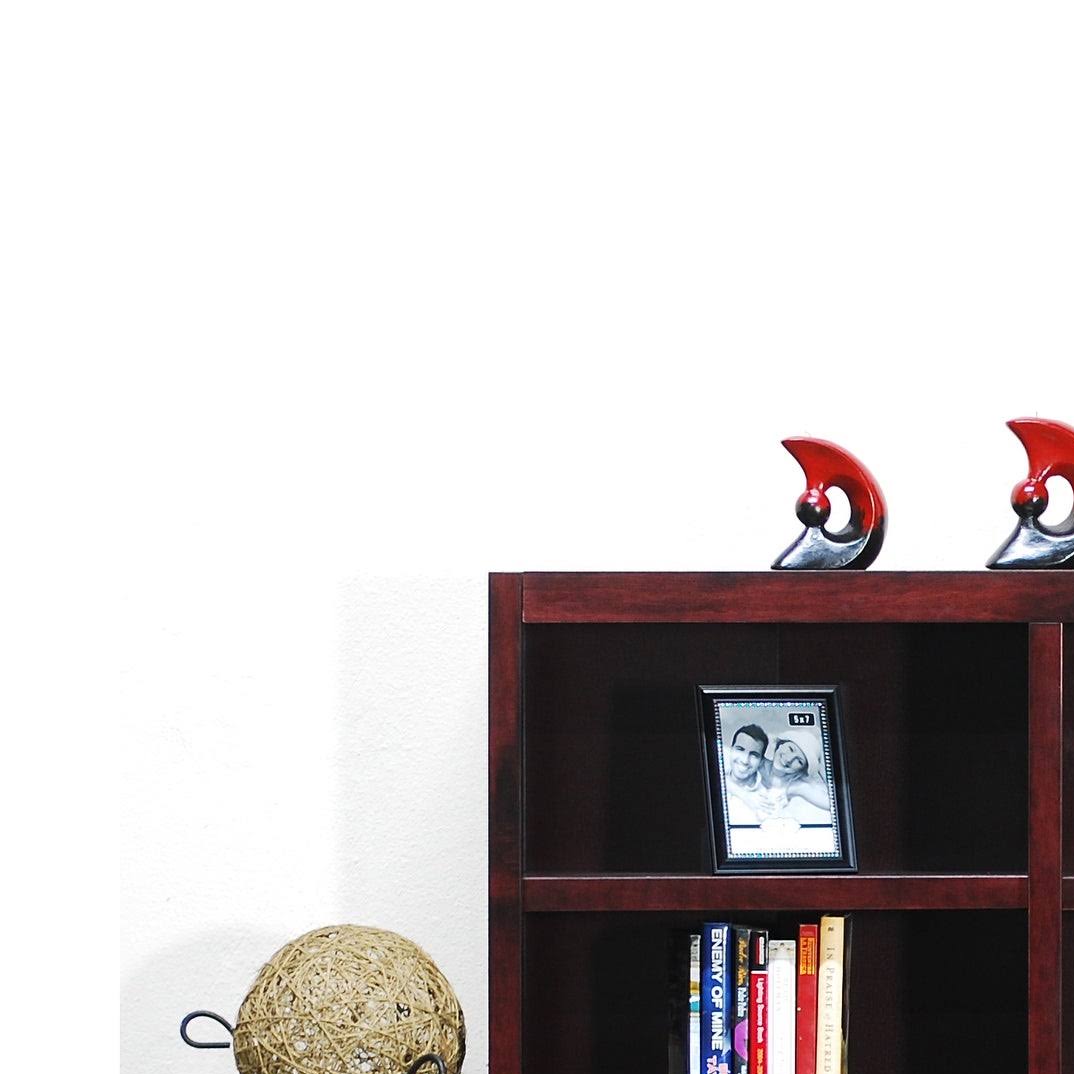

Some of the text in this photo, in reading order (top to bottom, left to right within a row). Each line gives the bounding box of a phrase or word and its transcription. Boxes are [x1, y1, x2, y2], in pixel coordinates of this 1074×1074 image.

[711, 928, 724, 1051] ENEMY OF MINE
[756, 977, 766, 1003] Lighting
[825, 967, 836, 1009] PRAISE
[823, 1023, 834, 1073] HATRED
